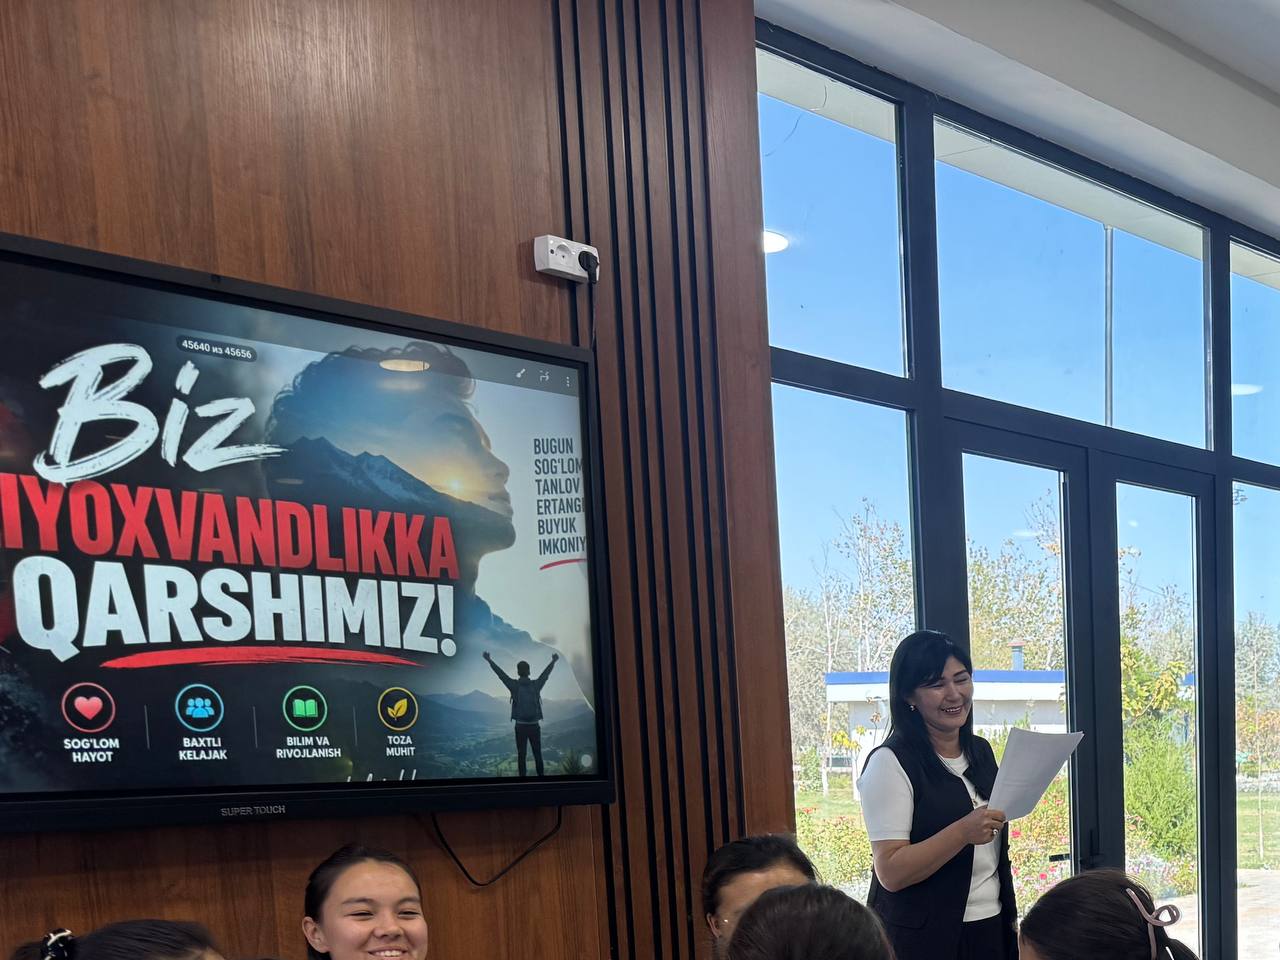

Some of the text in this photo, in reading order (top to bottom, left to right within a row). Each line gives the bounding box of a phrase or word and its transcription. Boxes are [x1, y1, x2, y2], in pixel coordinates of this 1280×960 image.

[182, 339, 210, 352] 45640
[224, 346, 252, 359] 45656
[33, 343, 289, 487] Biz
[533, 438, 574, 455] BUGUN
[535, 477, 580, 495] TANLOV
[0, 472, 460, 580] IYOXVANDLIKKA
[538, 517, 577, 535] BUYUK
[12, 555, 457, 662] QARSHIMIZ!
[63, 738, 120, 749] SOG'LOM
[183, 737, 222, 748] BAXTLI
[286, 736, 330, 746] BILIM VA
[387, 735, 412, 745] TOZA
[72, 751, 114, 763] HAYOT
[178, 750, 228, 761] KELAJAK
[276, 748, 342, 759] RIVOJLANISH
[386, 747, 416, 756] MUHIT
[221, 805, 286, 817] SUPER TOUCH
